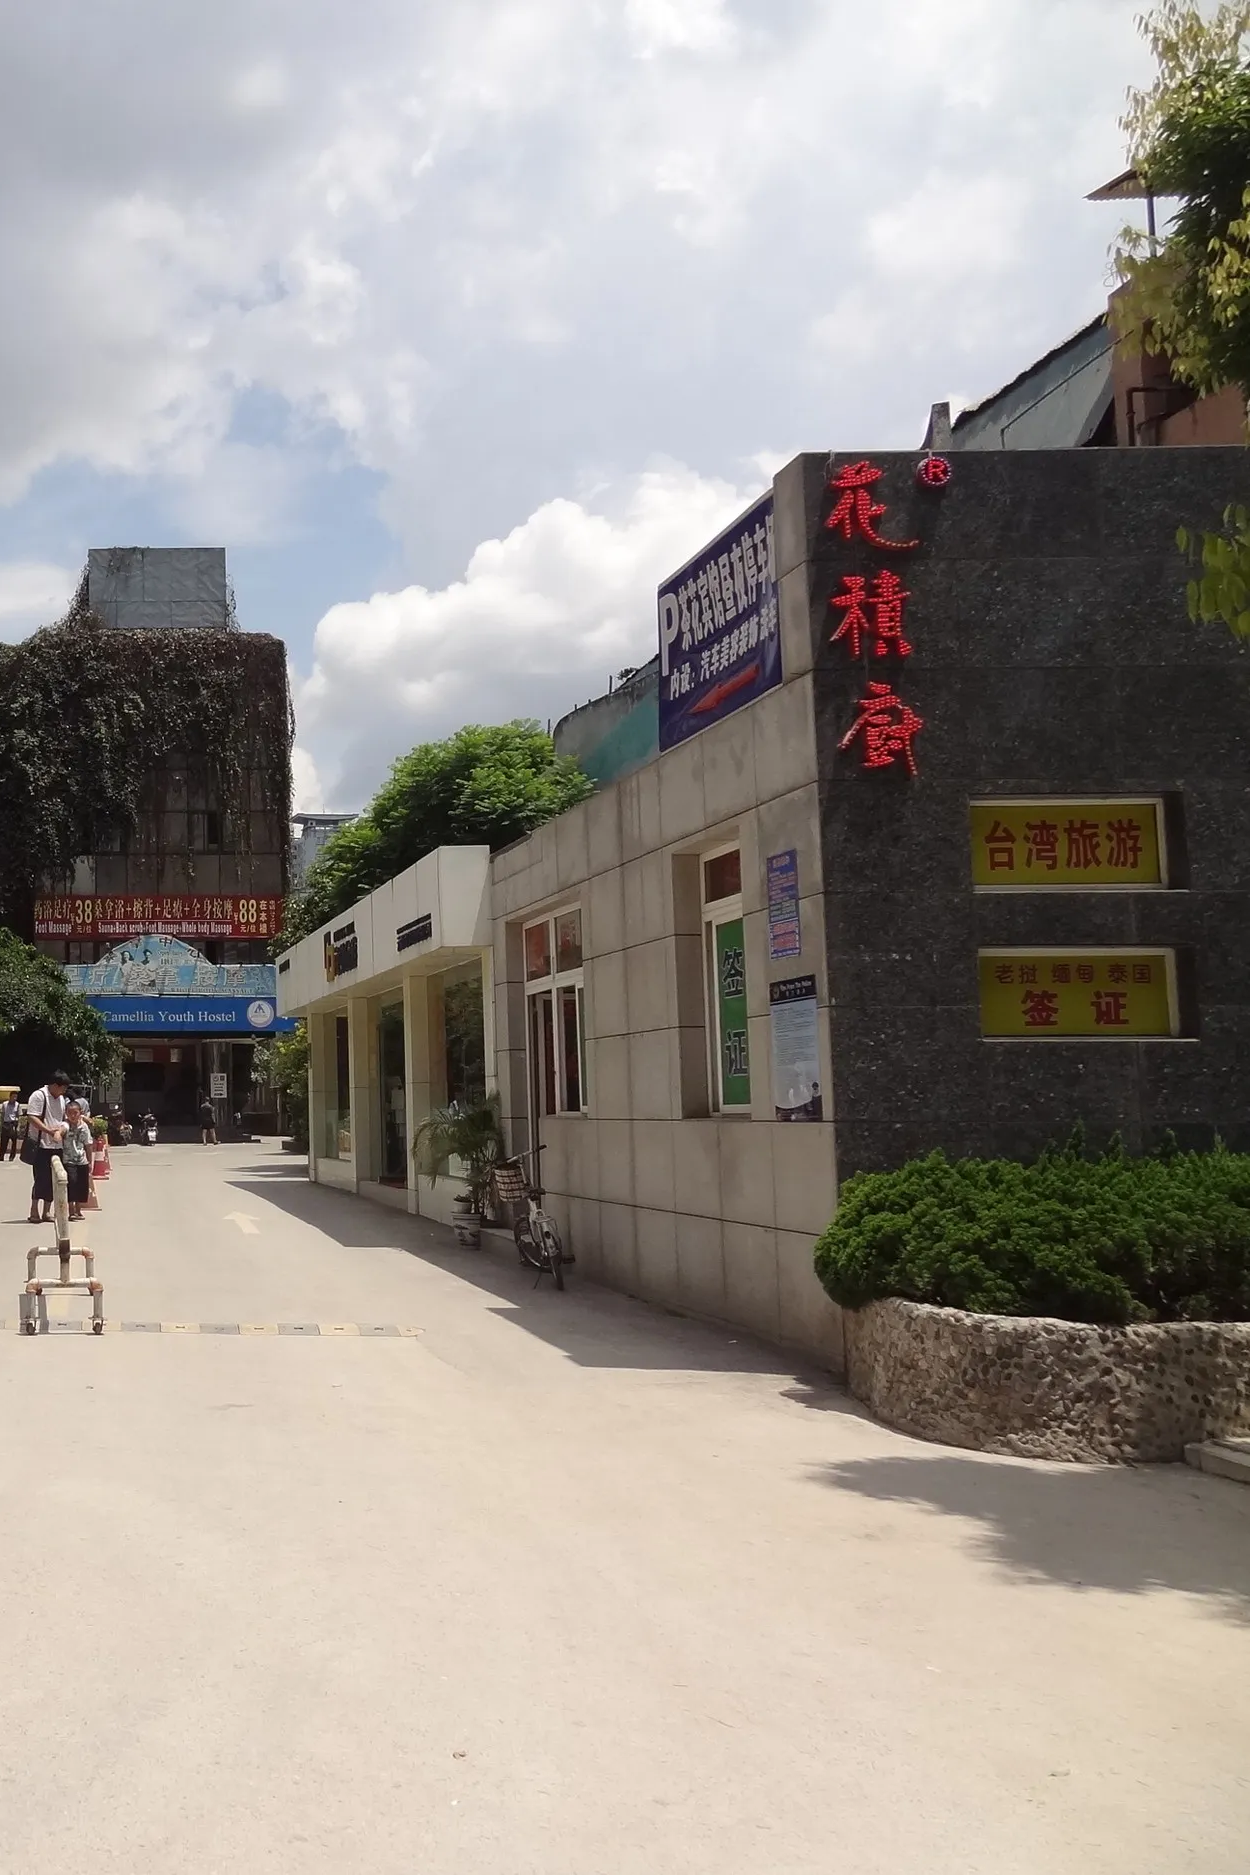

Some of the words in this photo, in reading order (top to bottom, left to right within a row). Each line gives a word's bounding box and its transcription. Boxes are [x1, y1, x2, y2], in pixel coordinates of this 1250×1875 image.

[984, 819, 1143, 871] 台湾旅游
[995, 964, 1038, 985] 老挝
[1051, 964, 1095, 984] 缅甸
[1107, 963, 1152, 984] 泰国
[103, 1010, 154, 1022] Camellia
[158, 1010, 194, 1022] Youth
[198, 1010, 236, 1022] Hostel
